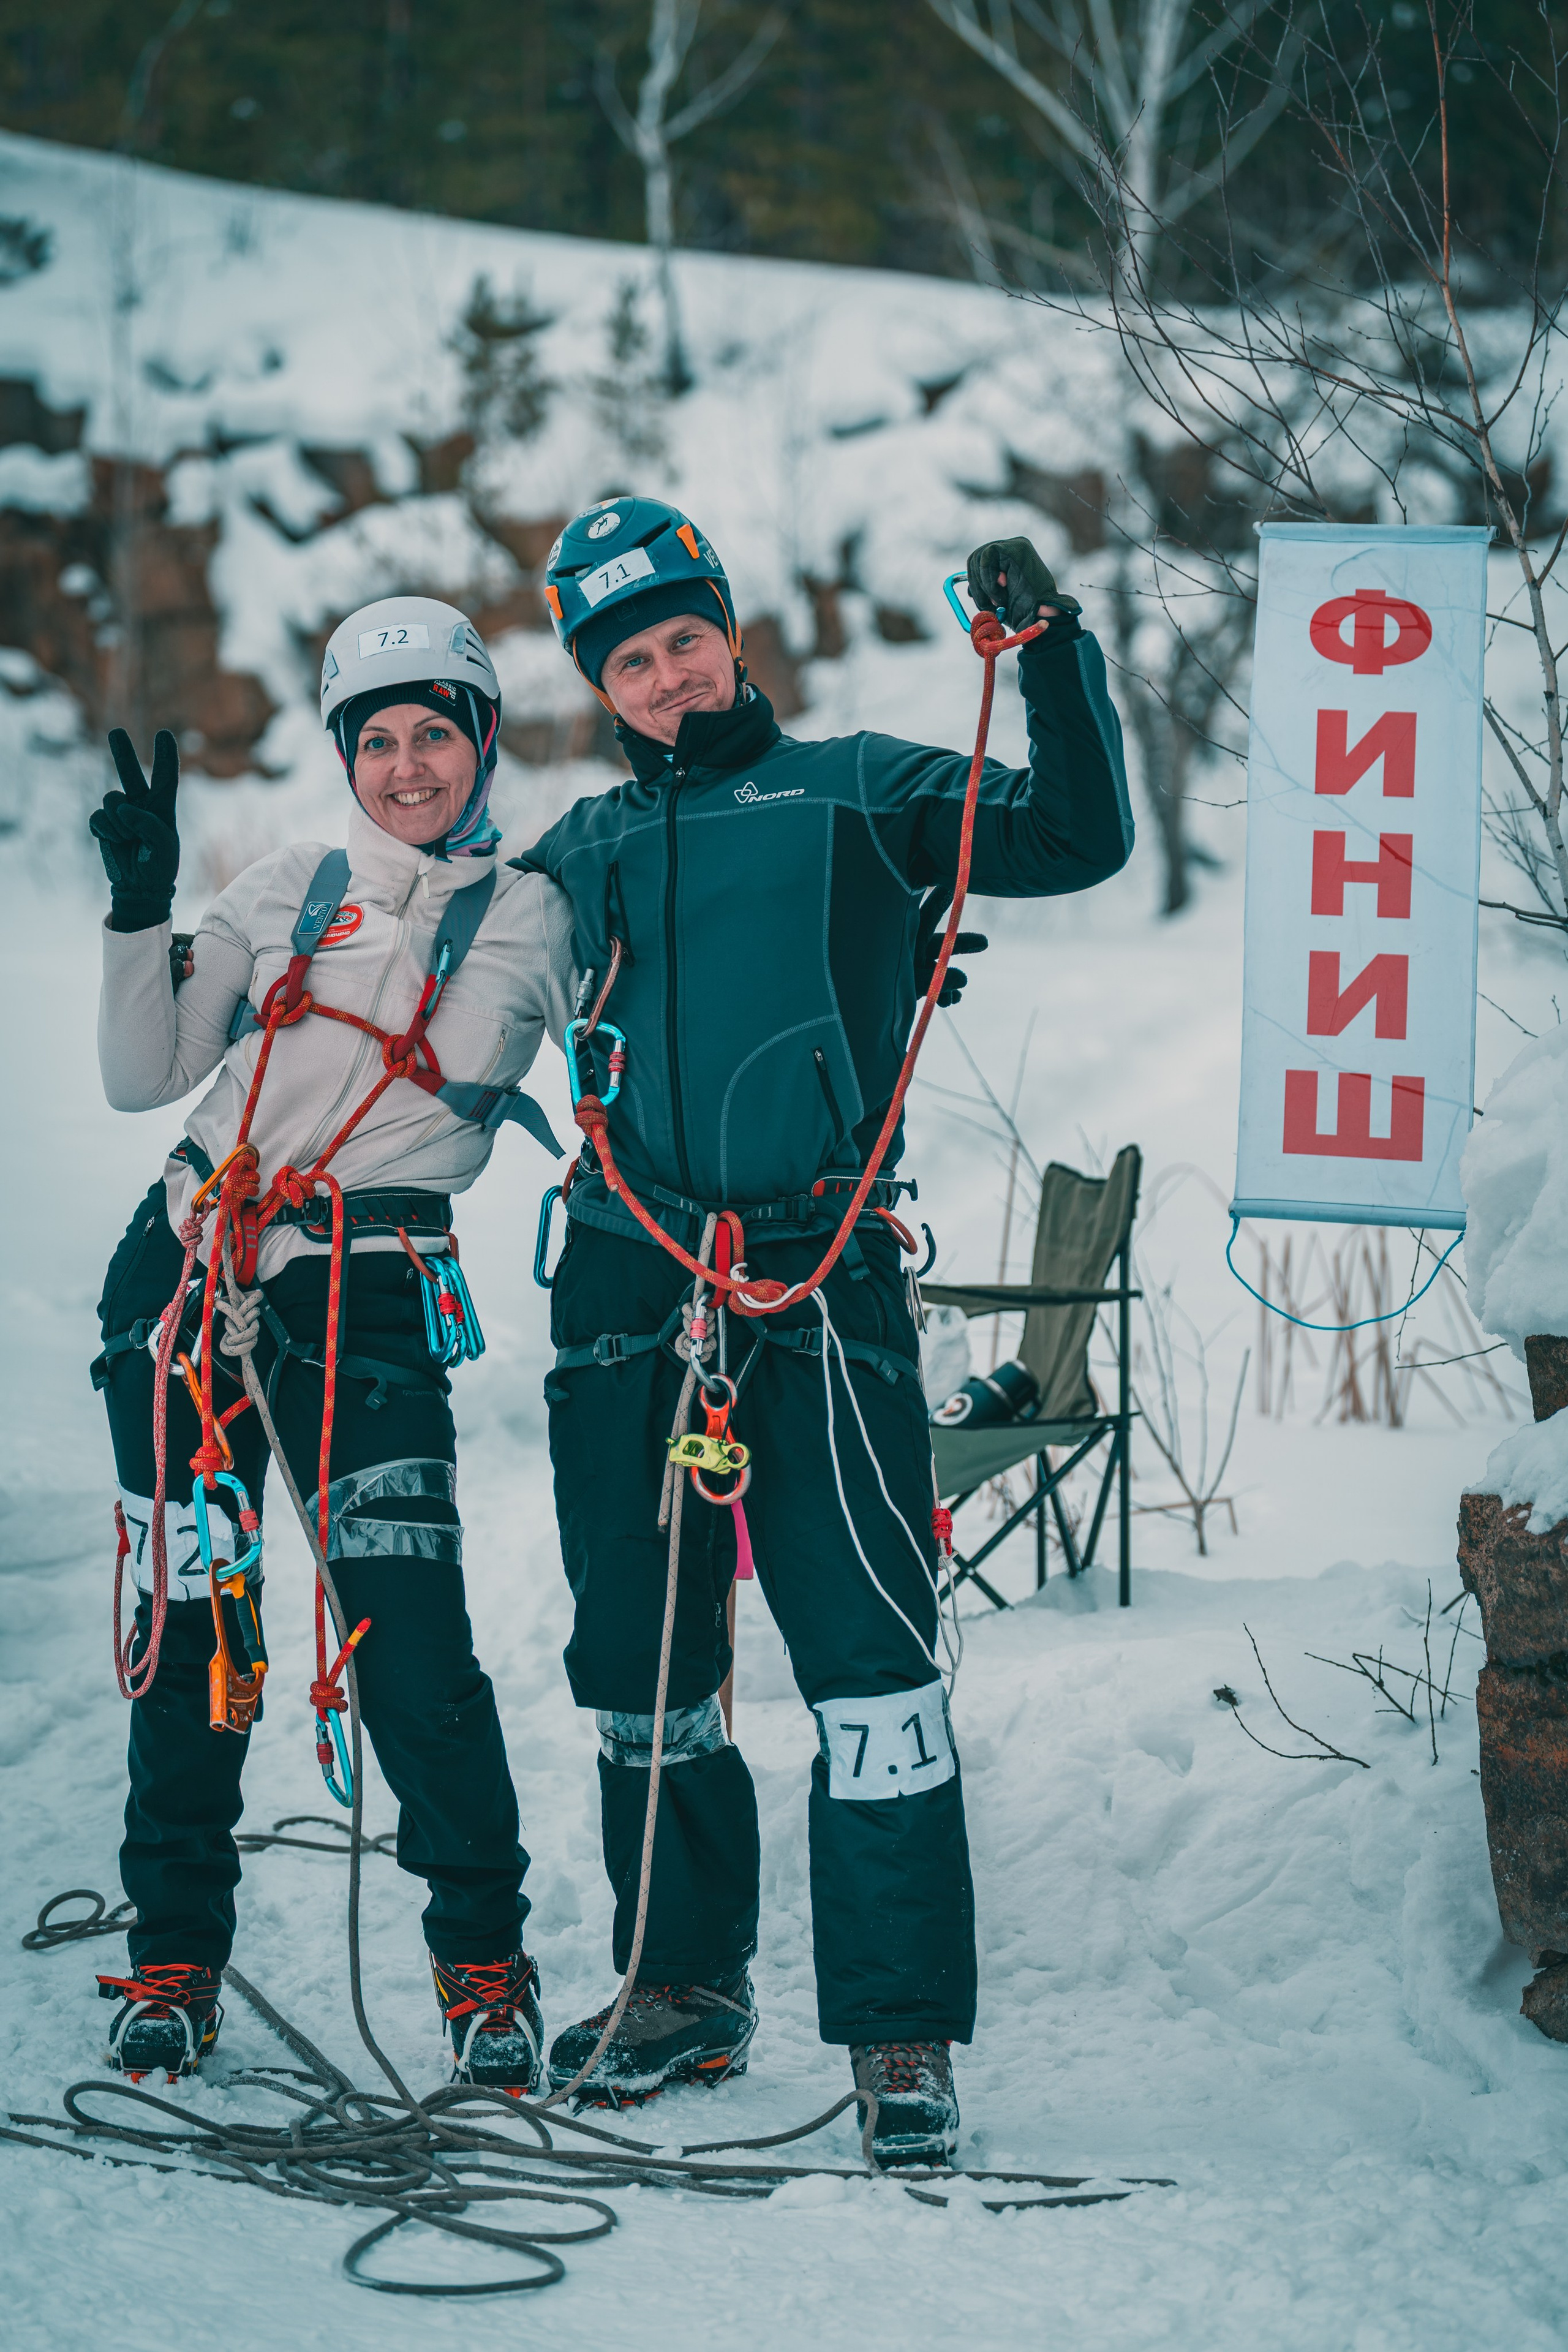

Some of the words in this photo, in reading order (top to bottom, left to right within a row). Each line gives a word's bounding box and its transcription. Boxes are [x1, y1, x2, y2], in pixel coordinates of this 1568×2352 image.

[599, 564, 631, 589] 7.1
[377, 629, 409, 647] 7.2
[432, 684, 450, 698] RAW
[748, 789, 805, 803] NORD
[1283, 589, 1432, 1162] ФИНИШ
[313, 907, 328, 929] VENTO
[840, 1713, 937, 1777] 7.1
